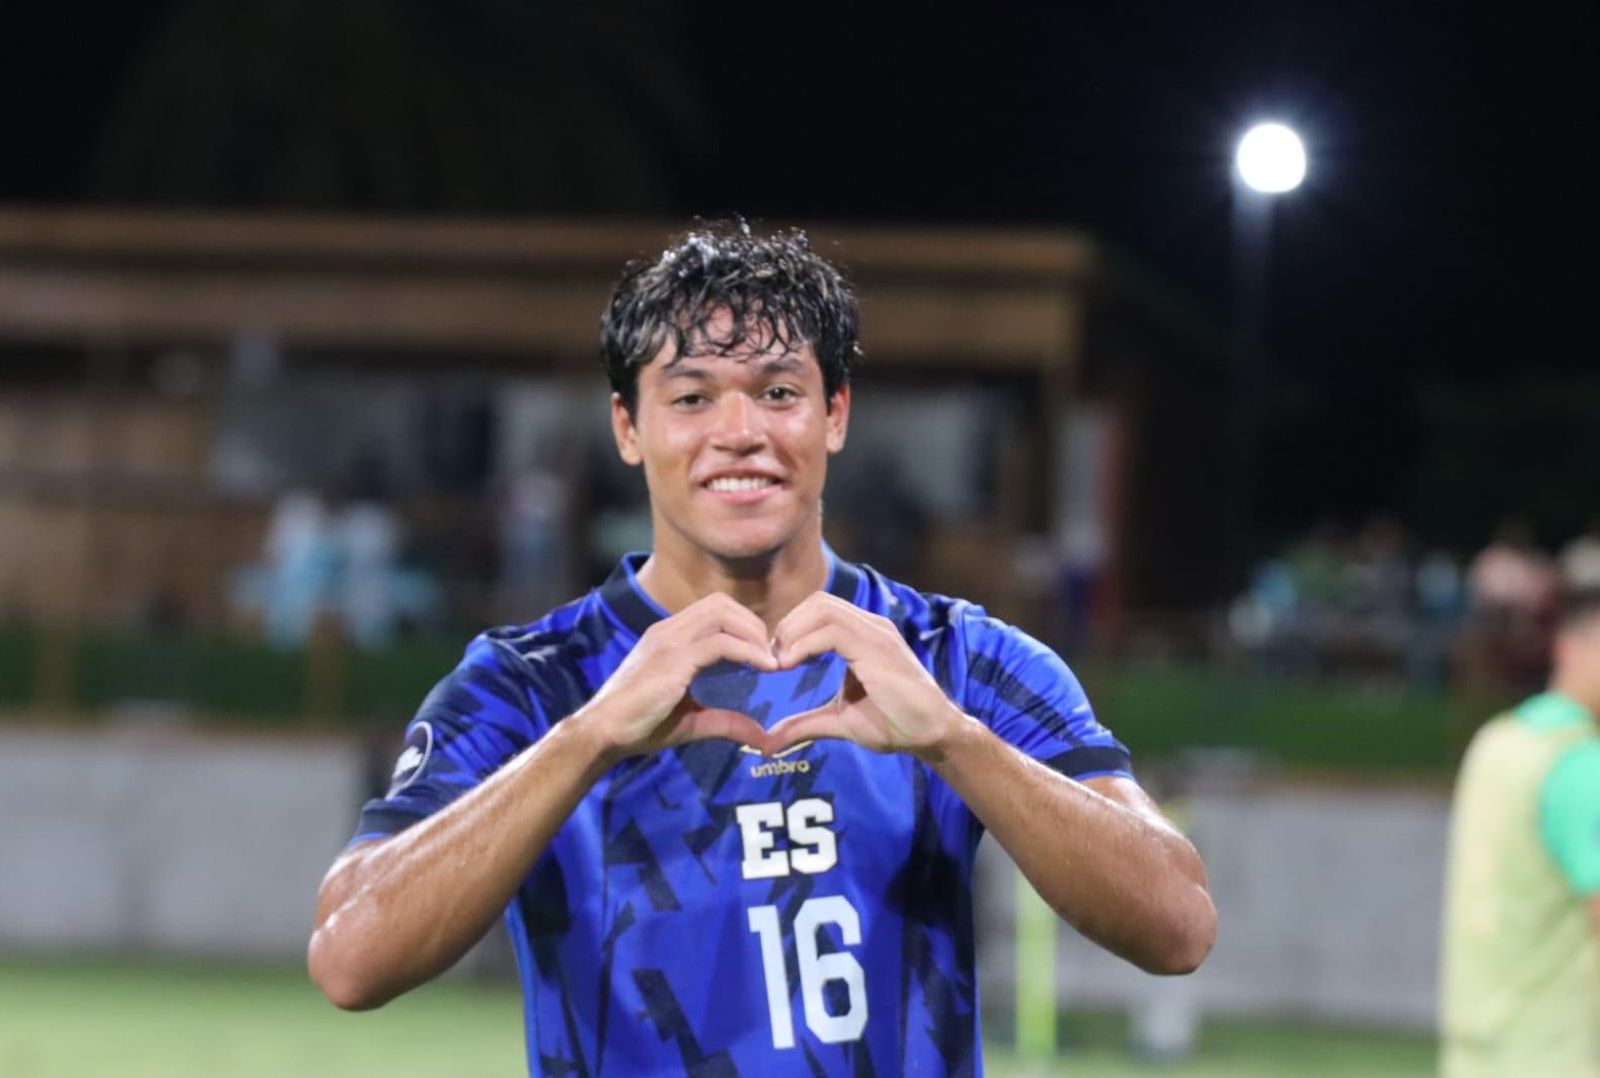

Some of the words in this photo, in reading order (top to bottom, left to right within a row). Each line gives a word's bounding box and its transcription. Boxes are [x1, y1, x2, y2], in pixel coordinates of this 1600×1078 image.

[750, 759, 810, 778] umbro
[736, 799, 838, 880] ES
[748, 895, 868, 1050] 16
